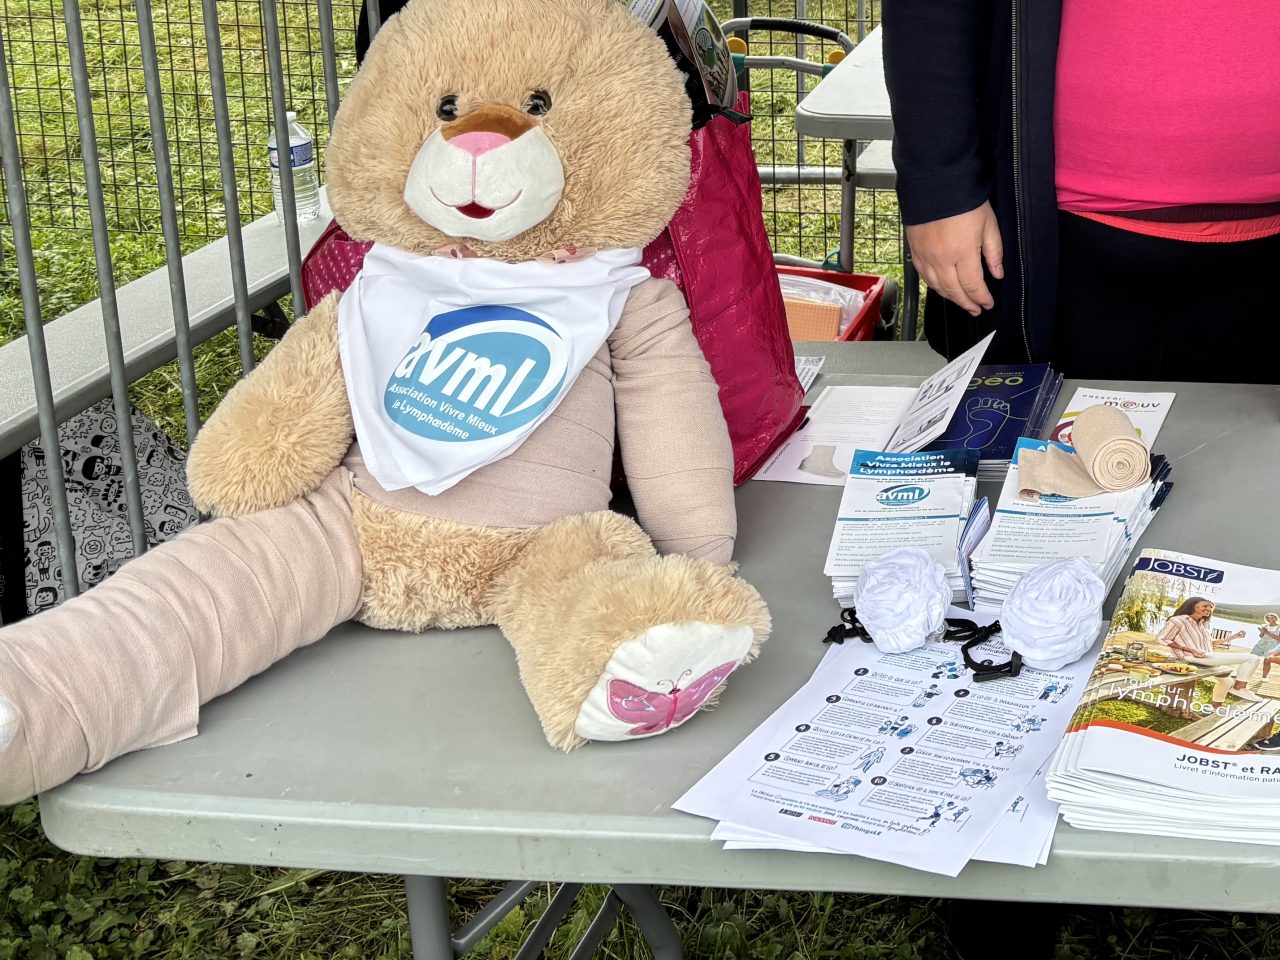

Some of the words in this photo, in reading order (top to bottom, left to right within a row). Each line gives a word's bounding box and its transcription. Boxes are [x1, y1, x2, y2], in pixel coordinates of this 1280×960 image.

[400, 399, 470, 441] Lymphœdème
[440, 402, 466, 422] Vivre
[468, 413, 498, 437] Mieux
[860, 467, 955, 475] Lymphœdème
[876, 489, 920, 500] avml
[1145, 557, 1209, 579] JOBST
[1123, 676, 1154, 690] Tout
[1160, 684, 1185, 695] sur
[1188, 687, 1201, 698] le
[1174, 763, 1199, 774] Livret
[1201, 768, 1260, 783] d'information
[1241, 765, 1256, 774] et
